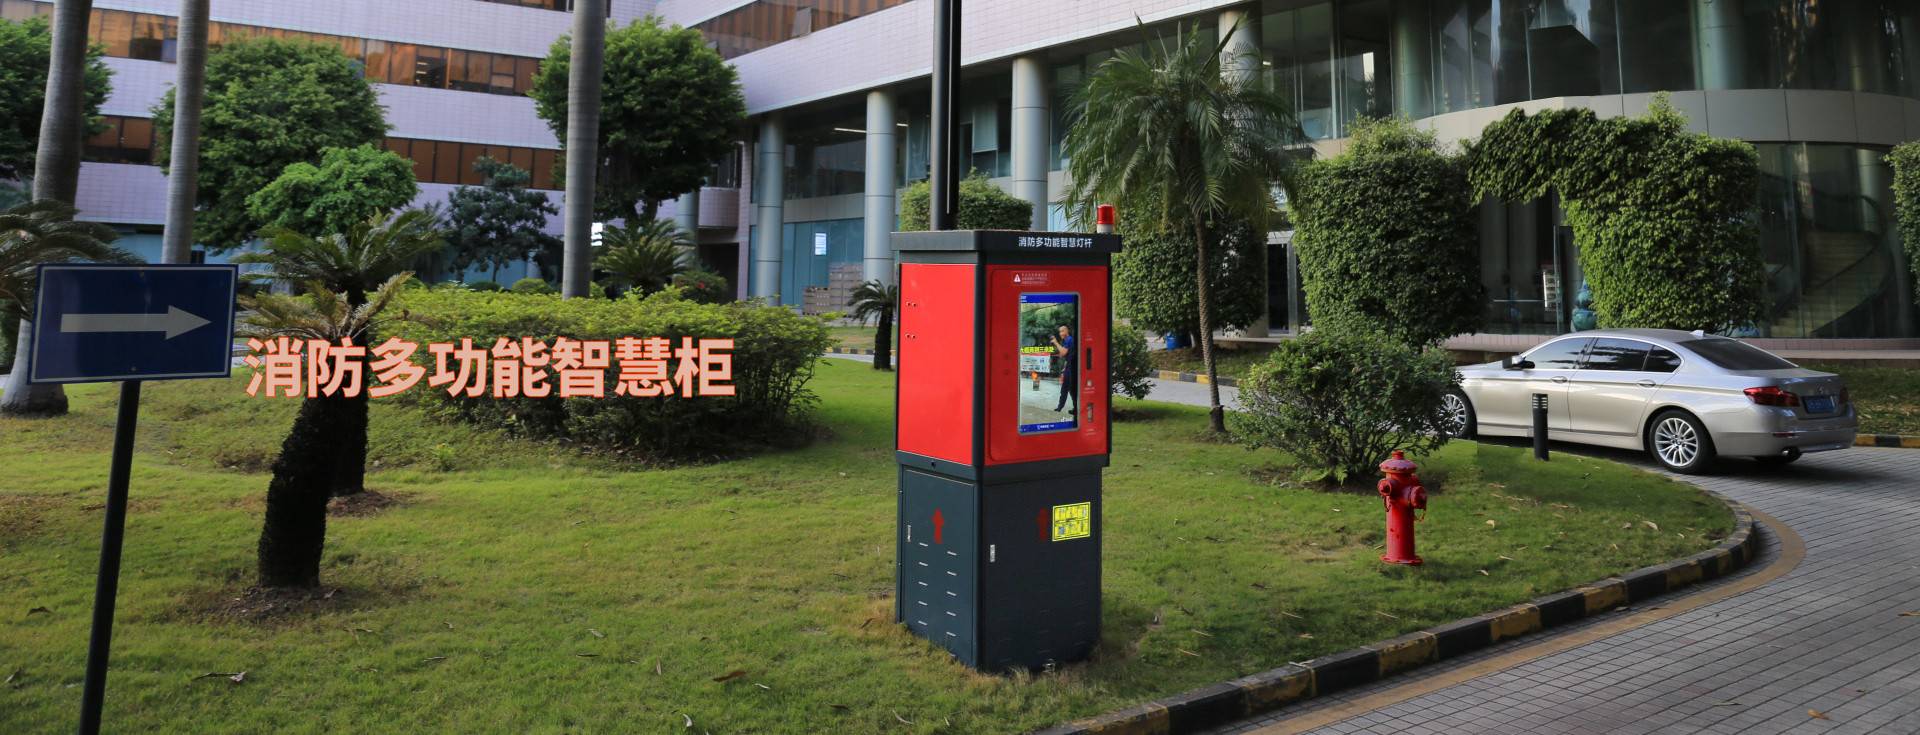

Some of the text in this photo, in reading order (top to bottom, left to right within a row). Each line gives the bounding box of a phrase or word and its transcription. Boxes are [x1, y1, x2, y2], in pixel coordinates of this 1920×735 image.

[1018, 236, 1093, 248] 消防多功能智慧灯杆
